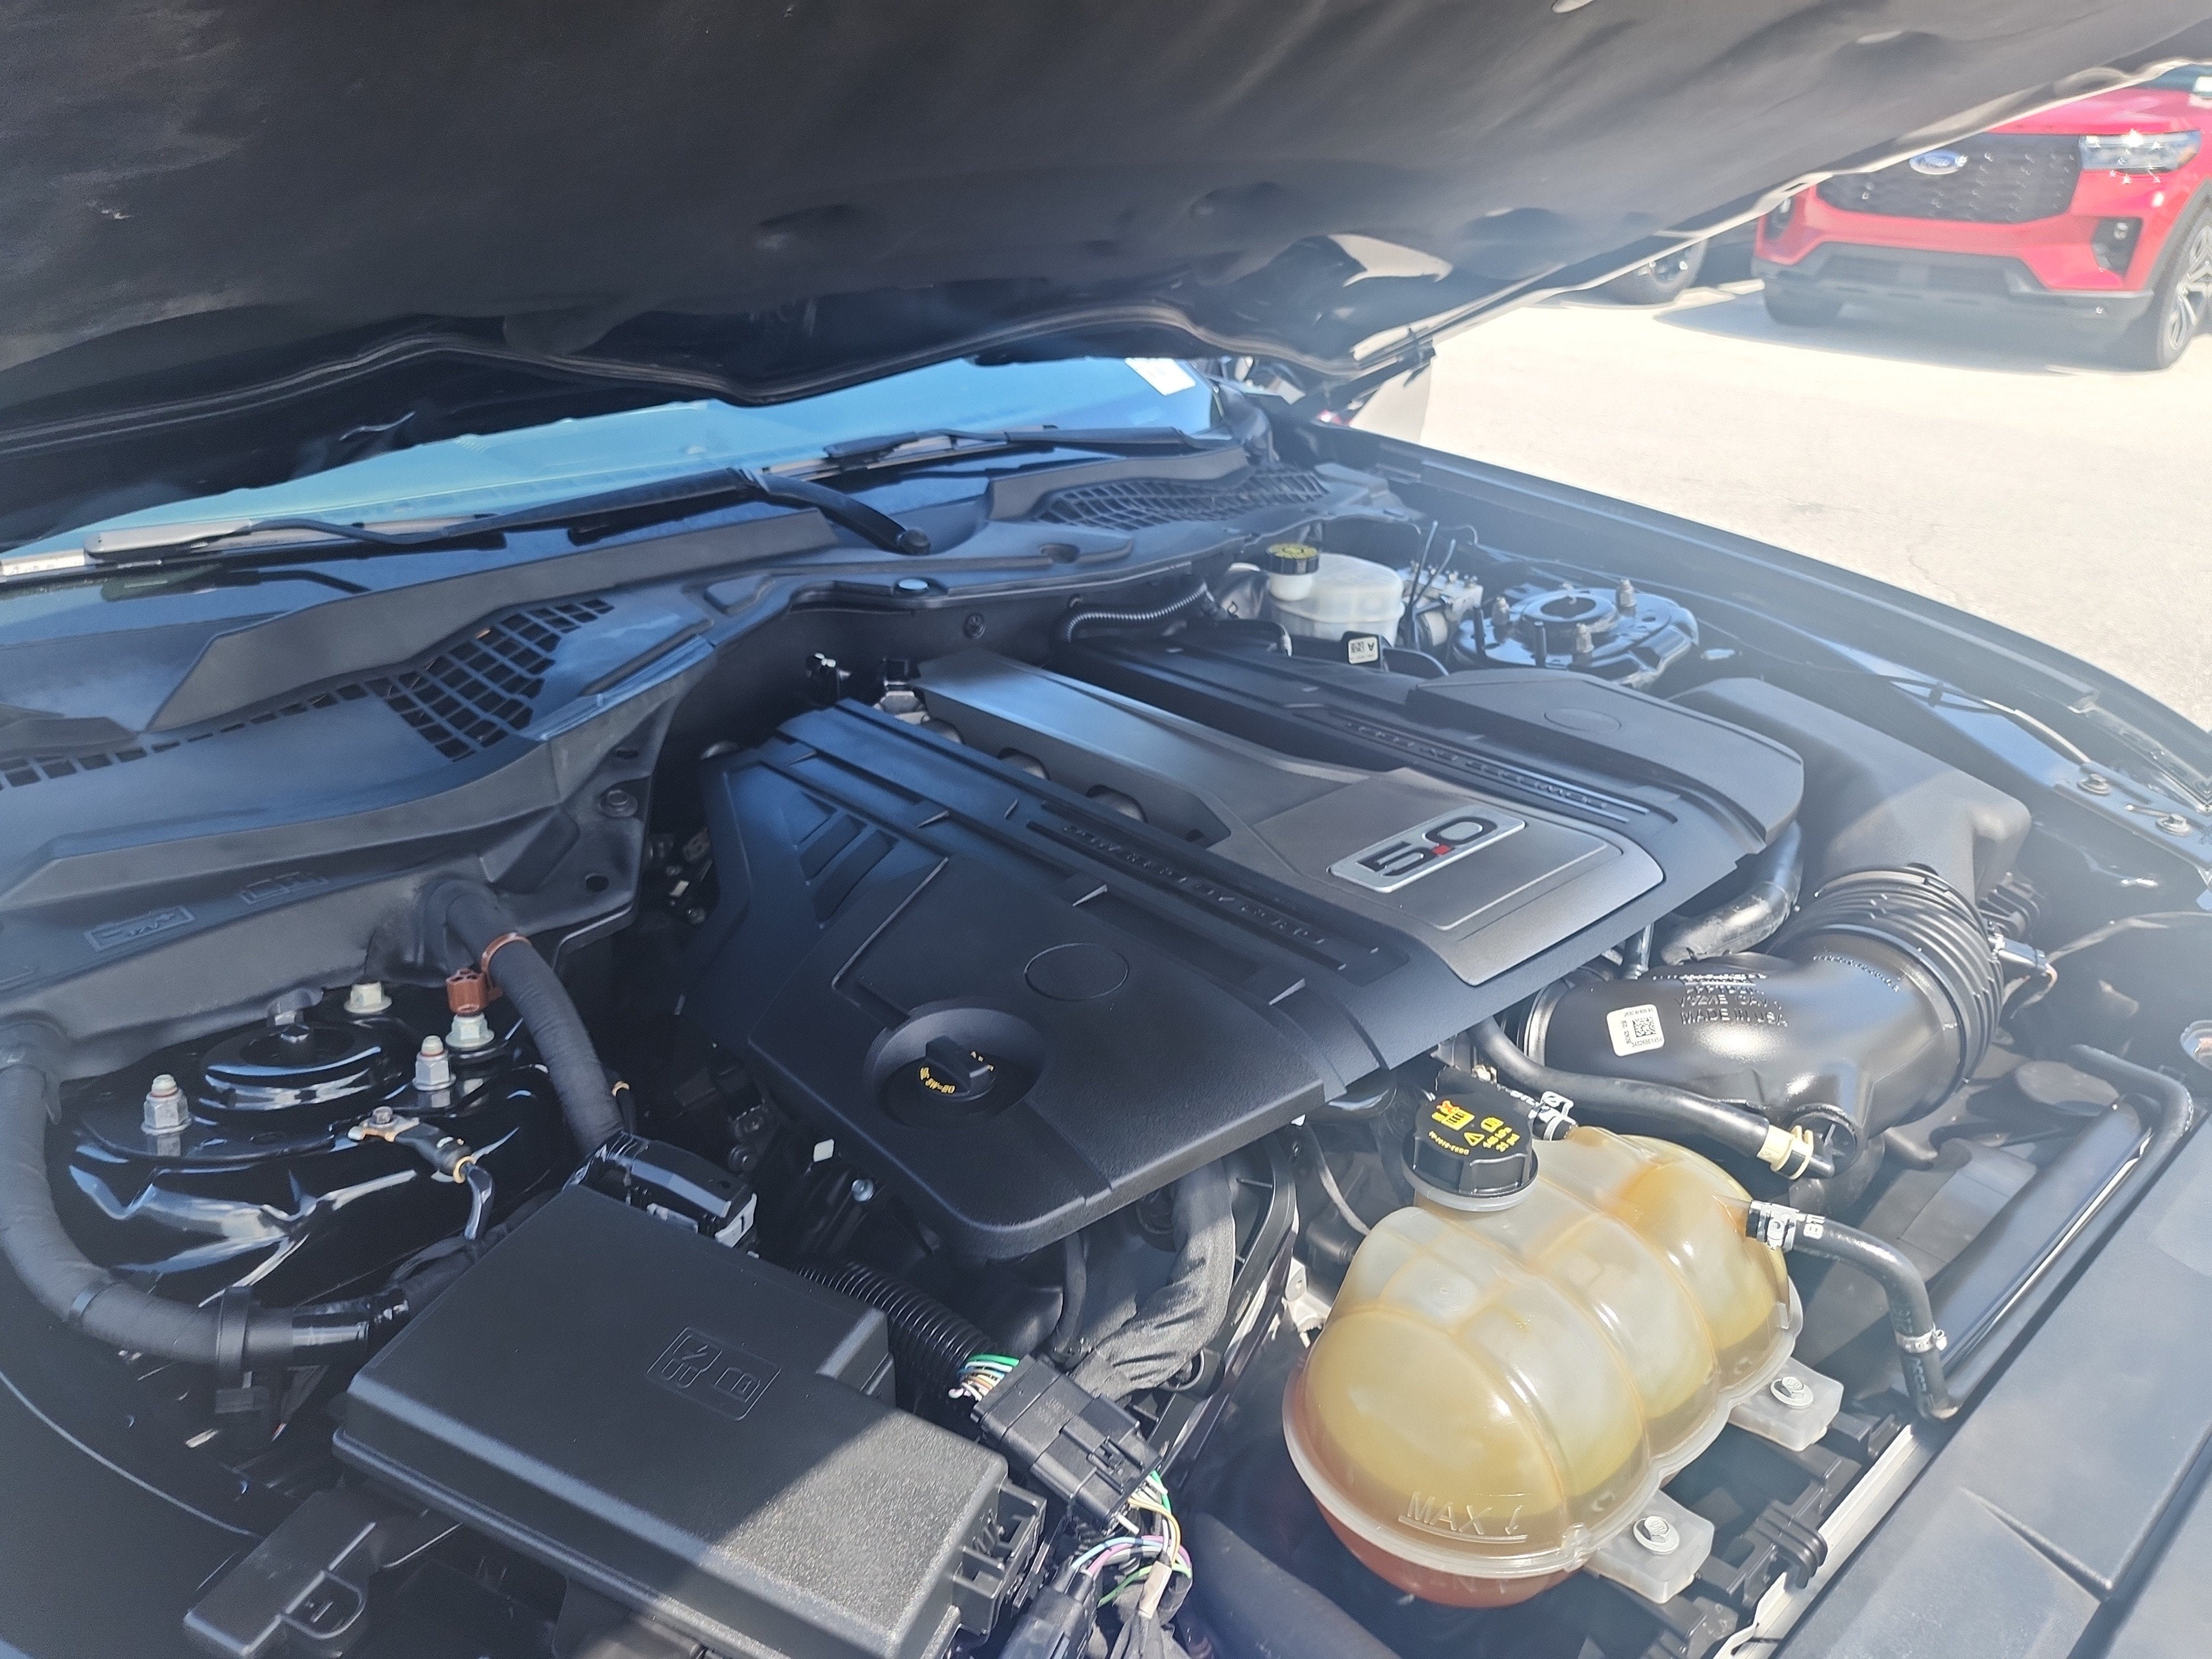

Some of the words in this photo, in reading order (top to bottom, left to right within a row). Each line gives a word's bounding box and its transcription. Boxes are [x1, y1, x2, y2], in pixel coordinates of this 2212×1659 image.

[1355, 816, 1497, 877] 5.0
[1681, 1008, 1730, 1025] MADE
[1734, 1008, 1751, 1022] IN
[1754, 1010, 1788, 1027] USA
[1407, 1491, 1492, 1535] MAX
